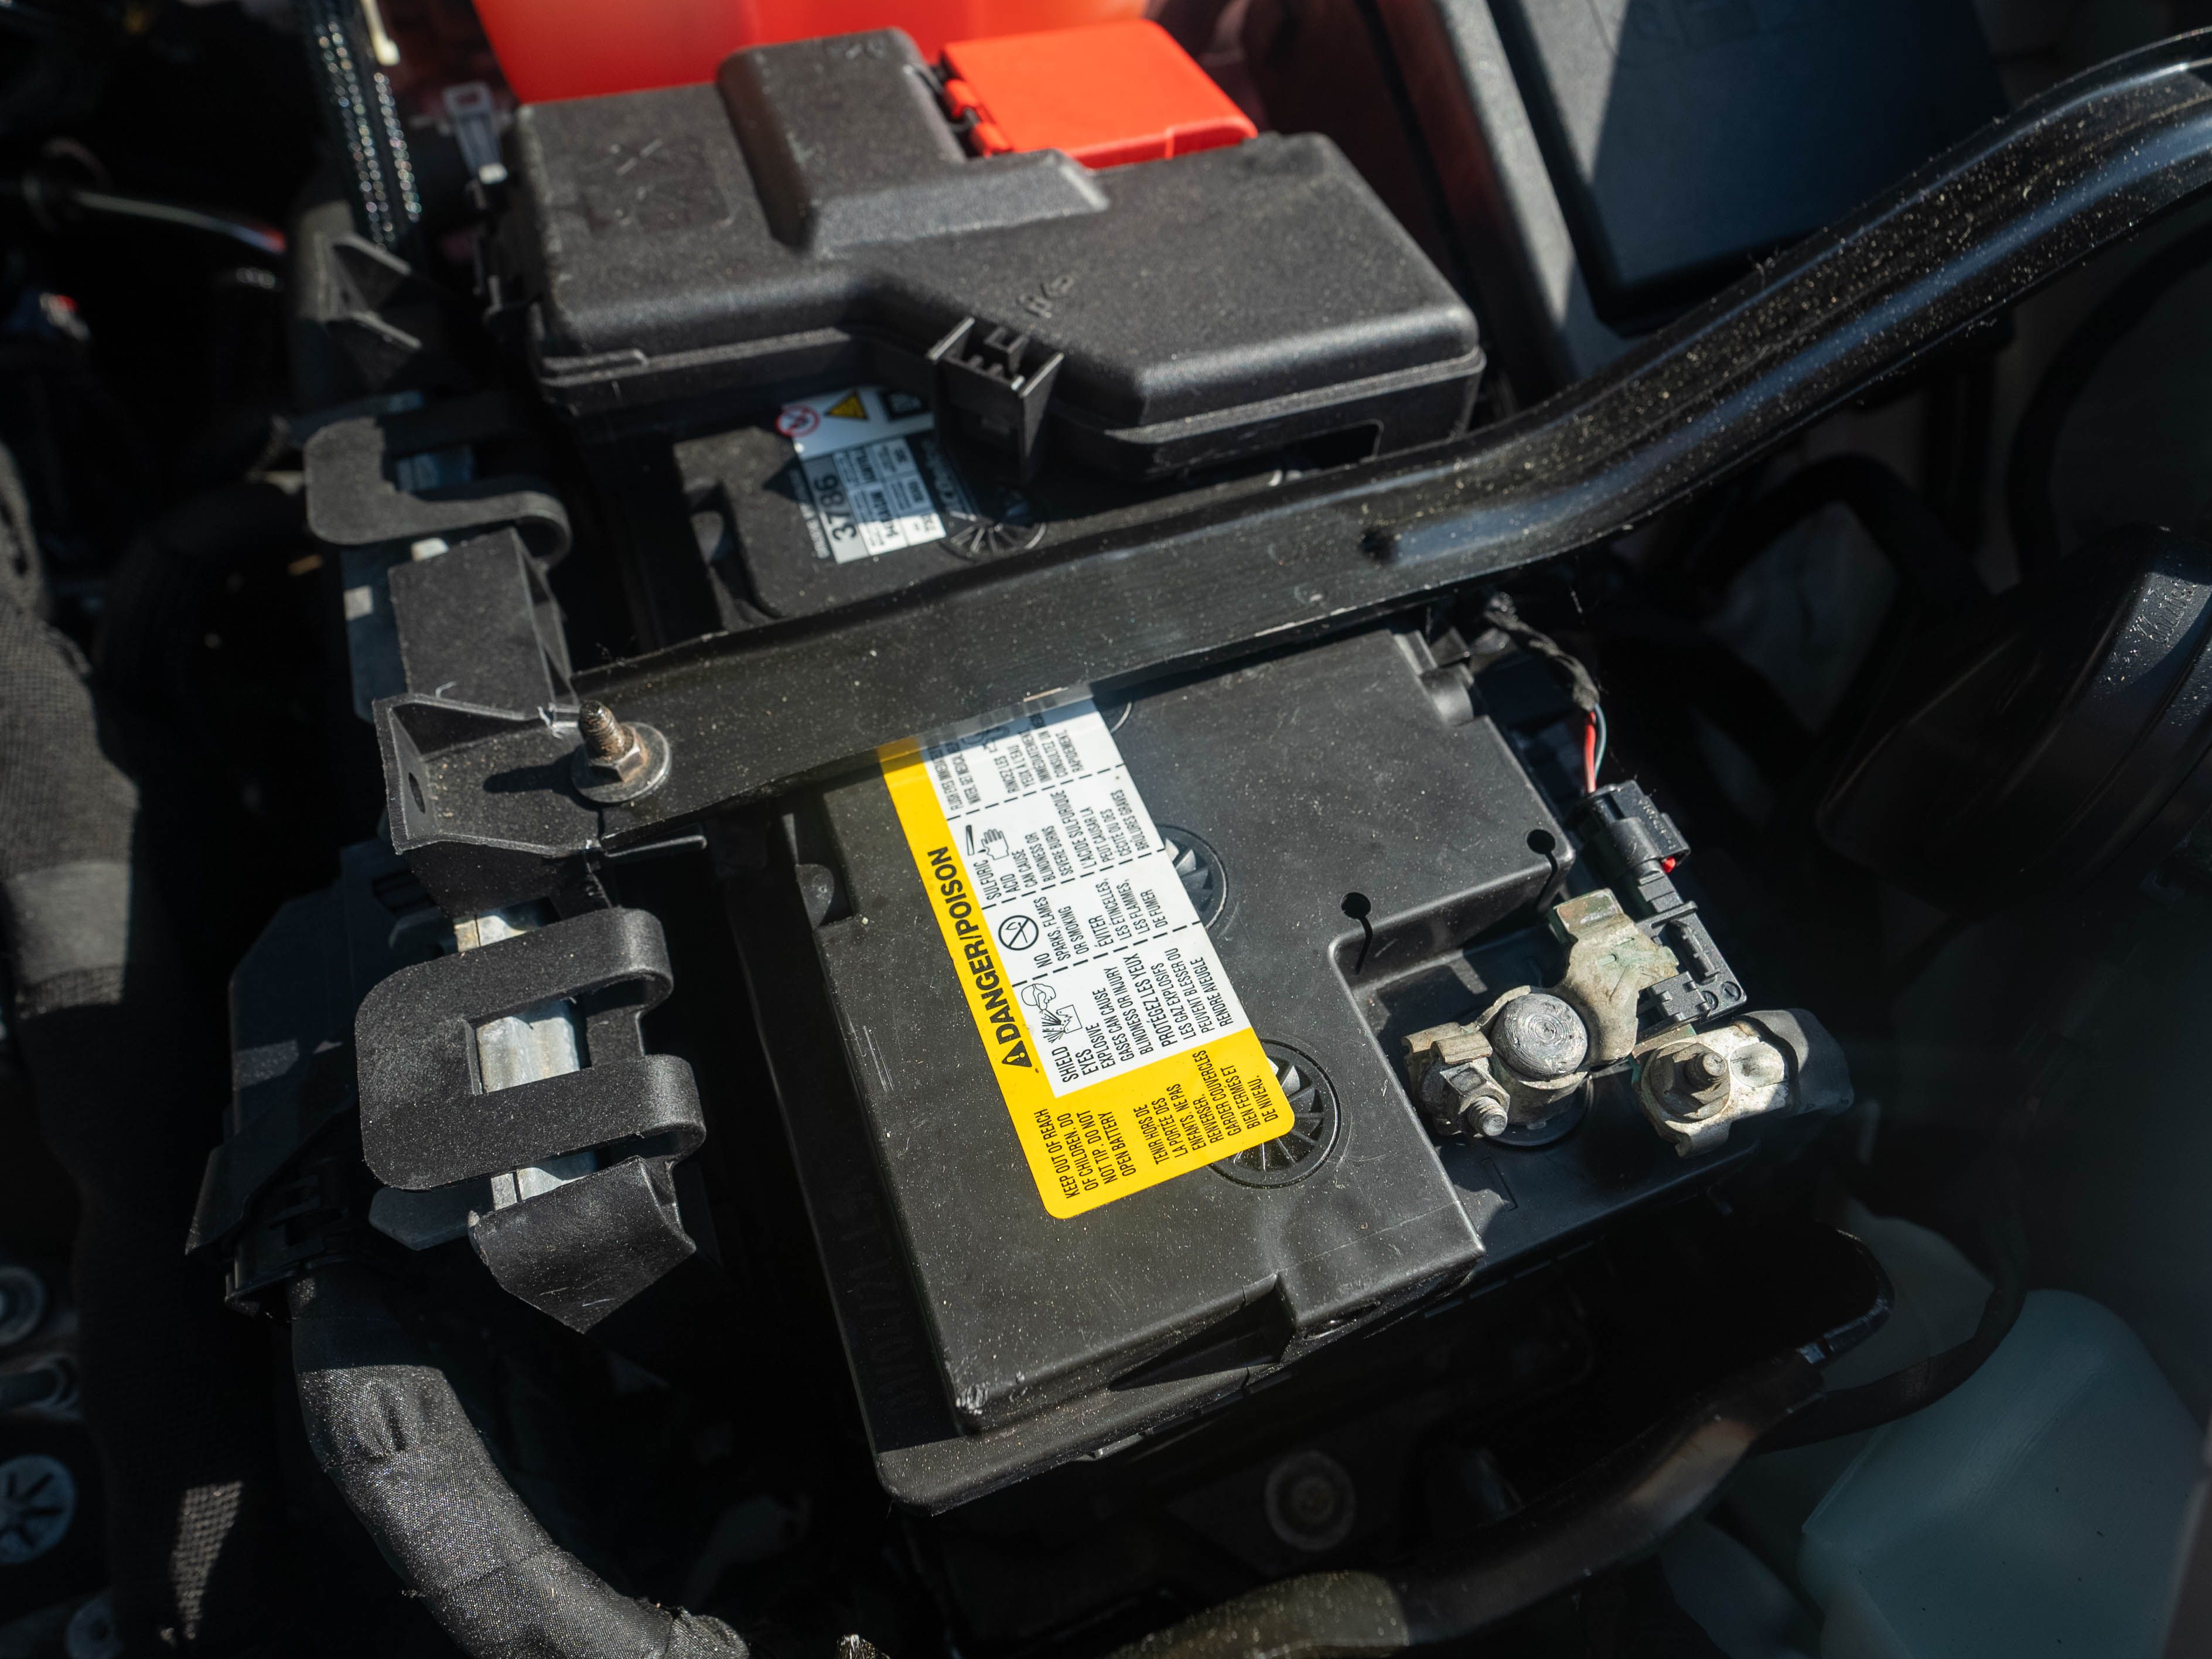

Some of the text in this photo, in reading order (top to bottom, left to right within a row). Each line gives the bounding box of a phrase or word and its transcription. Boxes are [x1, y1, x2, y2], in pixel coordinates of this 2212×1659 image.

[813, 473, 857, 542] 3786
[1100, 808, 1116, 822] DES
[1107, 822, 1121, 833] OU
[1110, 790, 1132, 815] GRAVES
[1042, 825, 1074, 876] SEVERE BURNS
[1050, 790, 1097, 869] L'ACIDE SULFURIQUE
[1080, 807, 1115, 863] PEUT CAUSAR LA
[973, 859, 1002, 900] SULFURIC
[1011, 849, 1038, 887] CAN CAUSE
[1025, 832, 1056, 882] BLINDNESS OR
[1000, 873, 1020, 893] ACID
[1033, 896, 1071, 961] SPARKS, FLAMES
[1058, 906, 1090, 955] OR SMOKING
[1088, 915, 1114, 947] ÉVITER
[1115, 924, 1132, 941] LES
[1133, 919, 1151, 934] LES
[1140, 889, 1168, 929] DE FUMER
[927, 846, 1022, 1045] DANGER/POISON
[1033, 953, 1053, 968] NO
[1103, 967, 1154, 1055] BLINDNESS OR INJURY
[1122, 952, 1178, 1047] PROTÉGEZ LES YEUX
[1151, 962, 1197, 1040] LES GAZ EXPLOSIFS
[1165, 948, 1215, 1033] PEUVENT BLESSER OU
[1190, 957, 1234, 1027] RENDRE AVEUGLE
[1085, 1023, 1116, 1069] EXPLOSIVE
[1092, 988, 1135, 1061] GASES CAN CAUSE
[1052, 1046, 1079, 1083] SHIELD
[1074, 1047, 1100, 1076] EYES
[1166, 1084, 1207, 1151] ENFANTS. NE PAS
[1192, 1050, 1242, 1136] GARDER COUVERCLES
[1220, 1065, 1261, 1129] BIEN FERMÉS ET
[1247, 1075, 1279, 1122] DE NIVEAU.
[1076, 1110, 1096, 1130] NOT
[1084, 1129, 1102, 1145] DO
[1097, 1111, 1136, 1176] OPEN BATTERY
[1133, 1104, 1170, 1165] TENIR HORS DE
[1151, 1097, 1189, 1158] LA PORTÉE DES
[1193, 1094, 1224, 1143] RENVERSER.
[1034, 1108, 1080, 1199] KEEP OUT OF REACH
[1057, 1113, 1099, 1191] OF CHILDREN. DO
[1098, 1164, 1118, 1184] NOT
